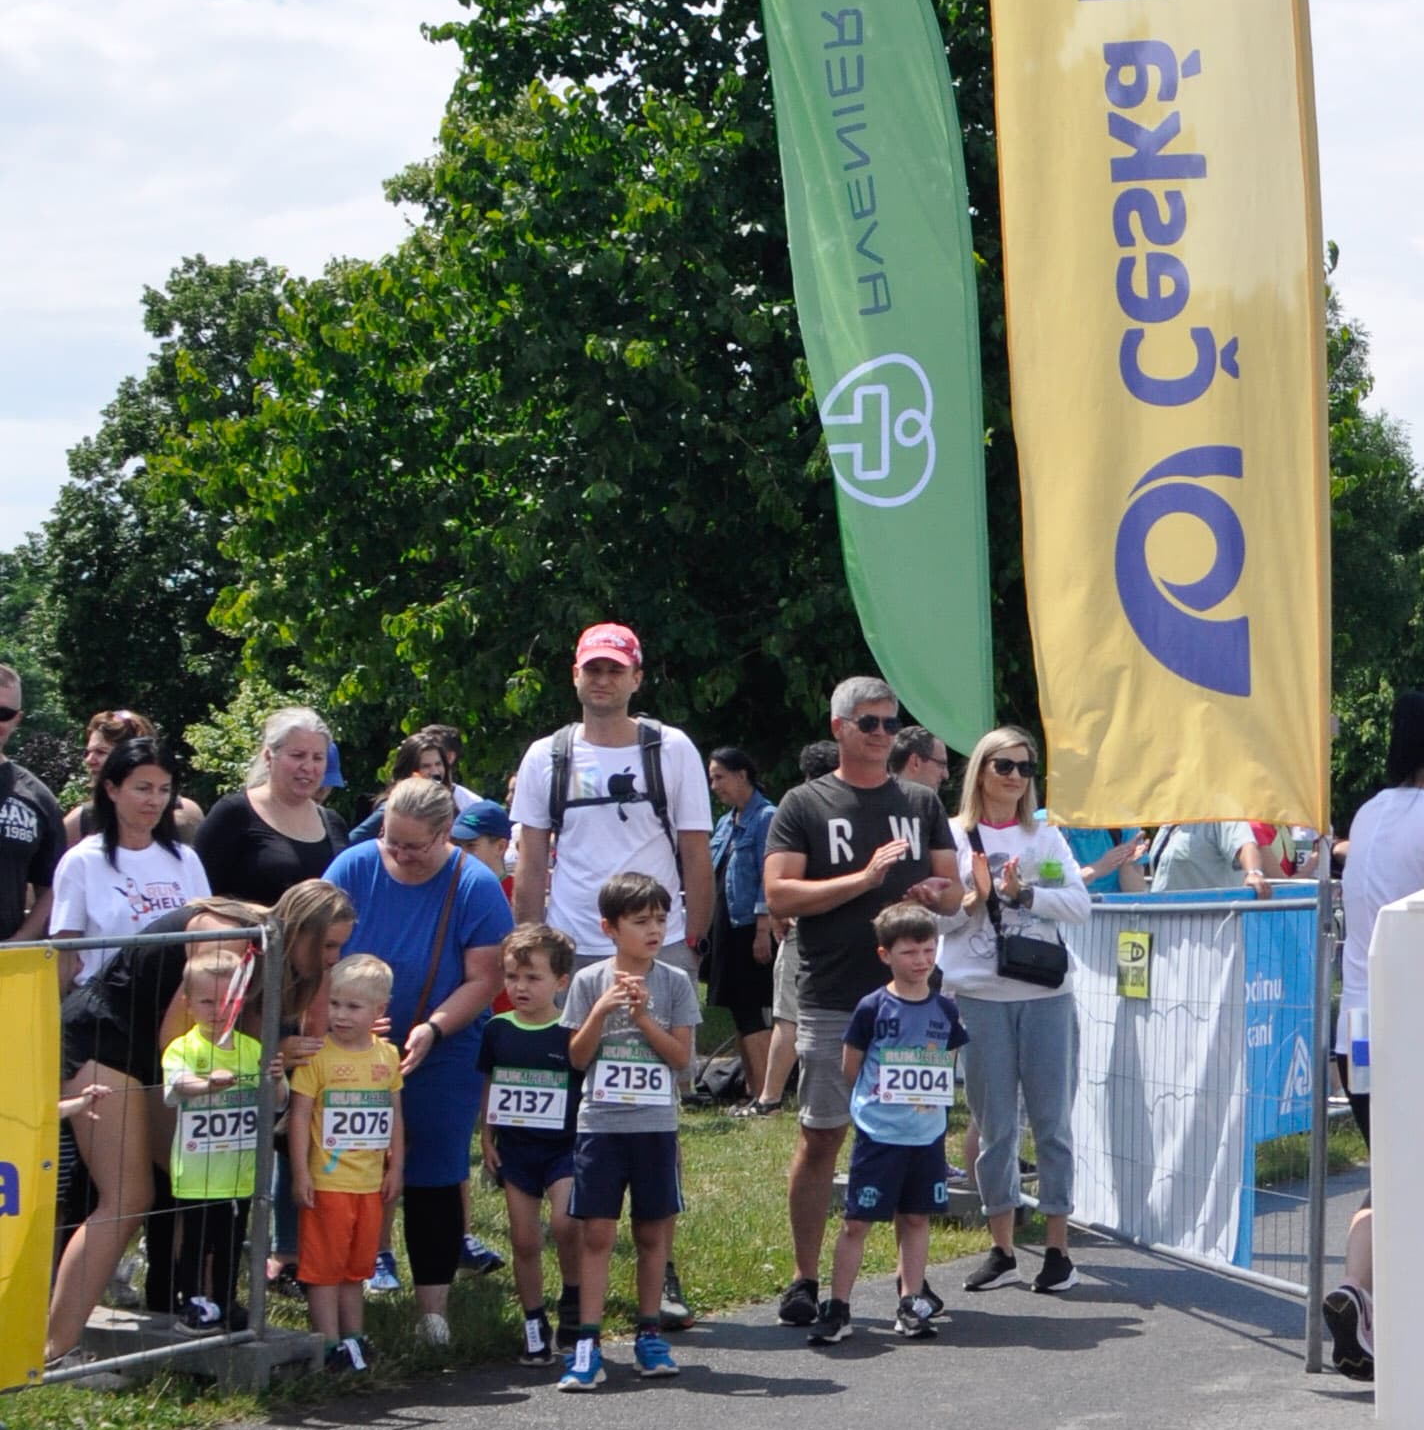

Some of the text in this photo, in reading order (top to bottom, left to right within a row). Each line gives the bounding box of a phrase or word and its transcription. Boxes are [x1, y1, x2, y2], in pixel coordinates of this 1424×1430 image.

[603, 1064, 663, 1091] 2136
[886, 1068, 949, 1092] 2004
[498, 1088, 555, 1114] 2137
[191, 1110, 258, 1139] 2079
[331, 1111, 389, 1136] 2076
